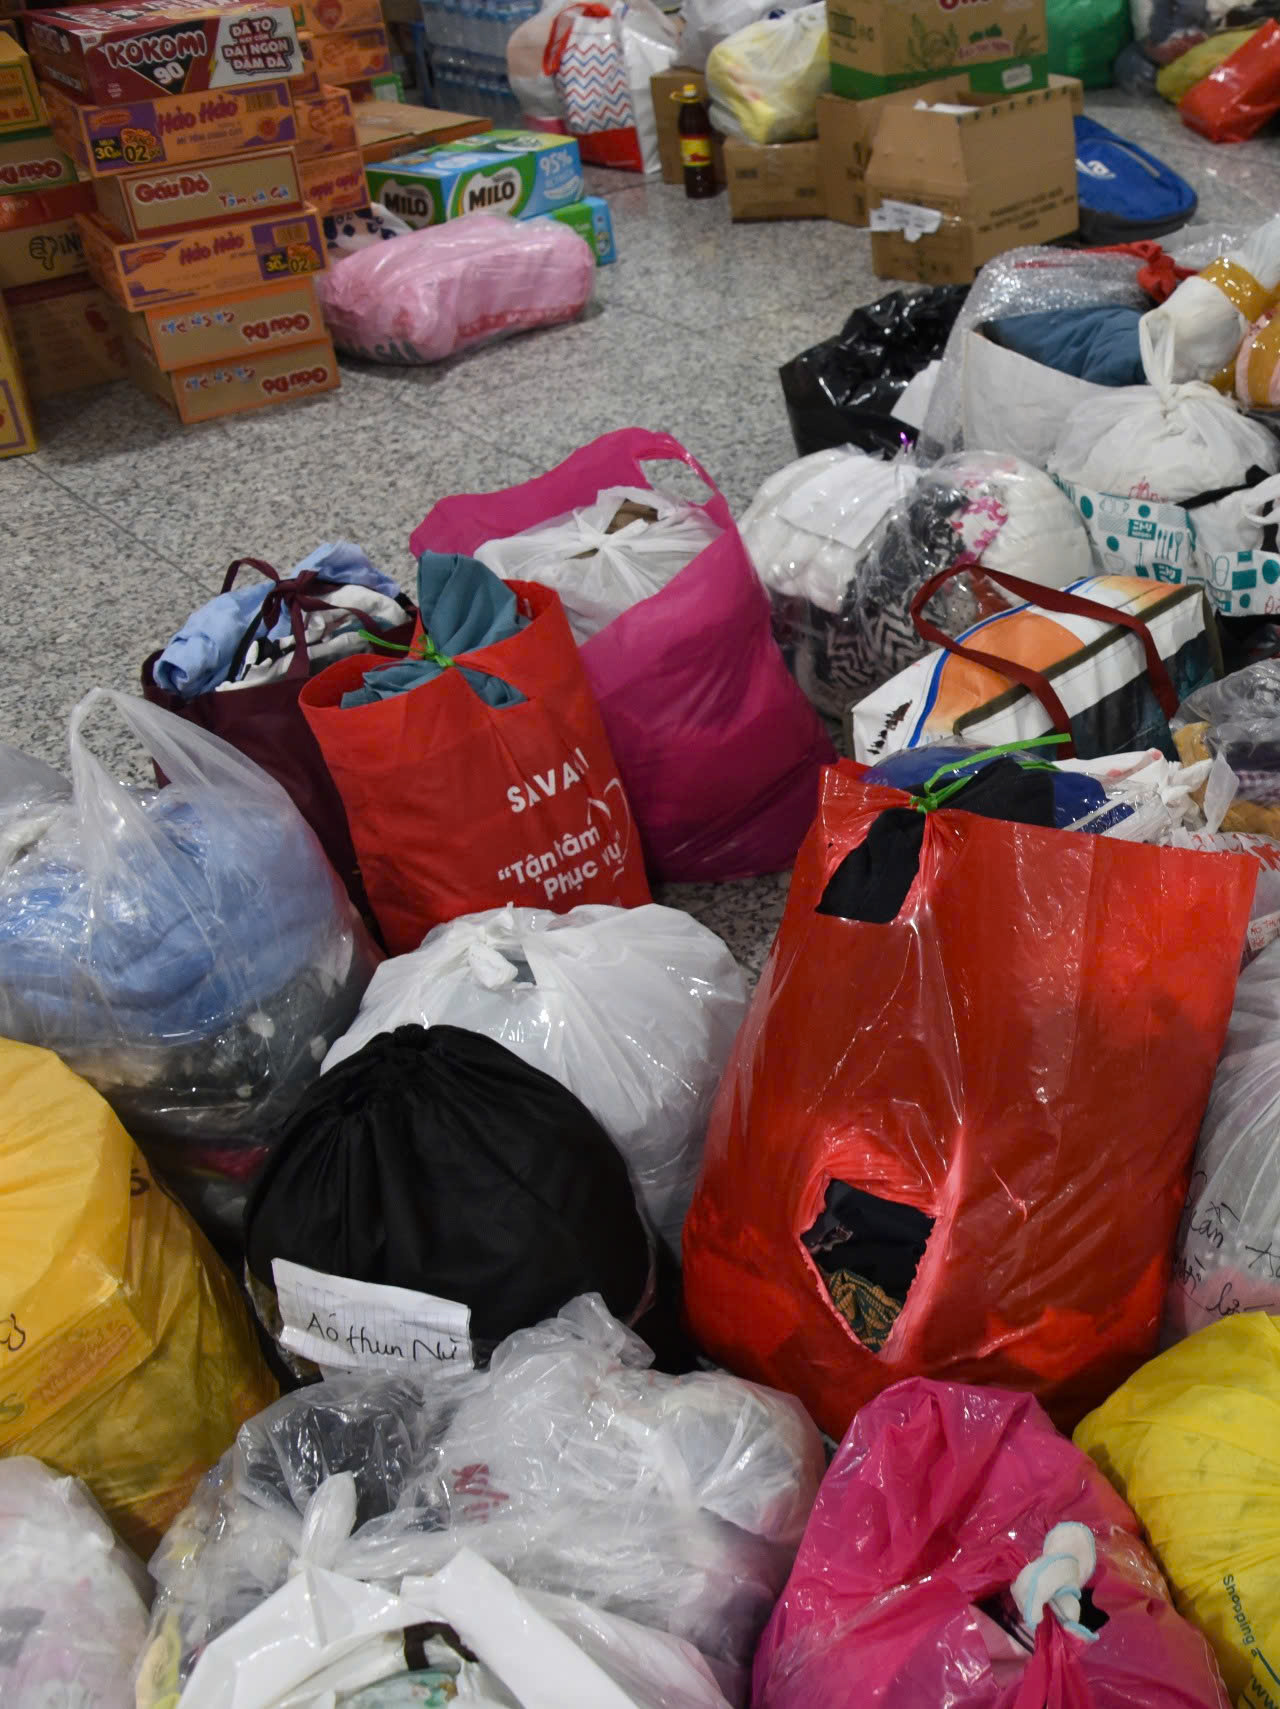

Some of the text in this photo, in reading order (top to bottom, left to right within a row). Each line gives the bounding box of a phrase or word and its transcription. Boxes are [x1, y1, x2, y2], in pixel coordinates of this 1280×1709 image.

[105, 31, 207, 68] KOKOMI
[249, 40, 289, 55] NGON
[153, 62, 184, 84] 90
[123, 144, 149, 162] 02
[540, 150, 573, 176] 95%
[385, 191, 428, 216] MILO
[469, 181, 515, 210] MILO
[347, 1324, 404, 1359] thun
[1222, 1573, 1256, 1646] Shopping
